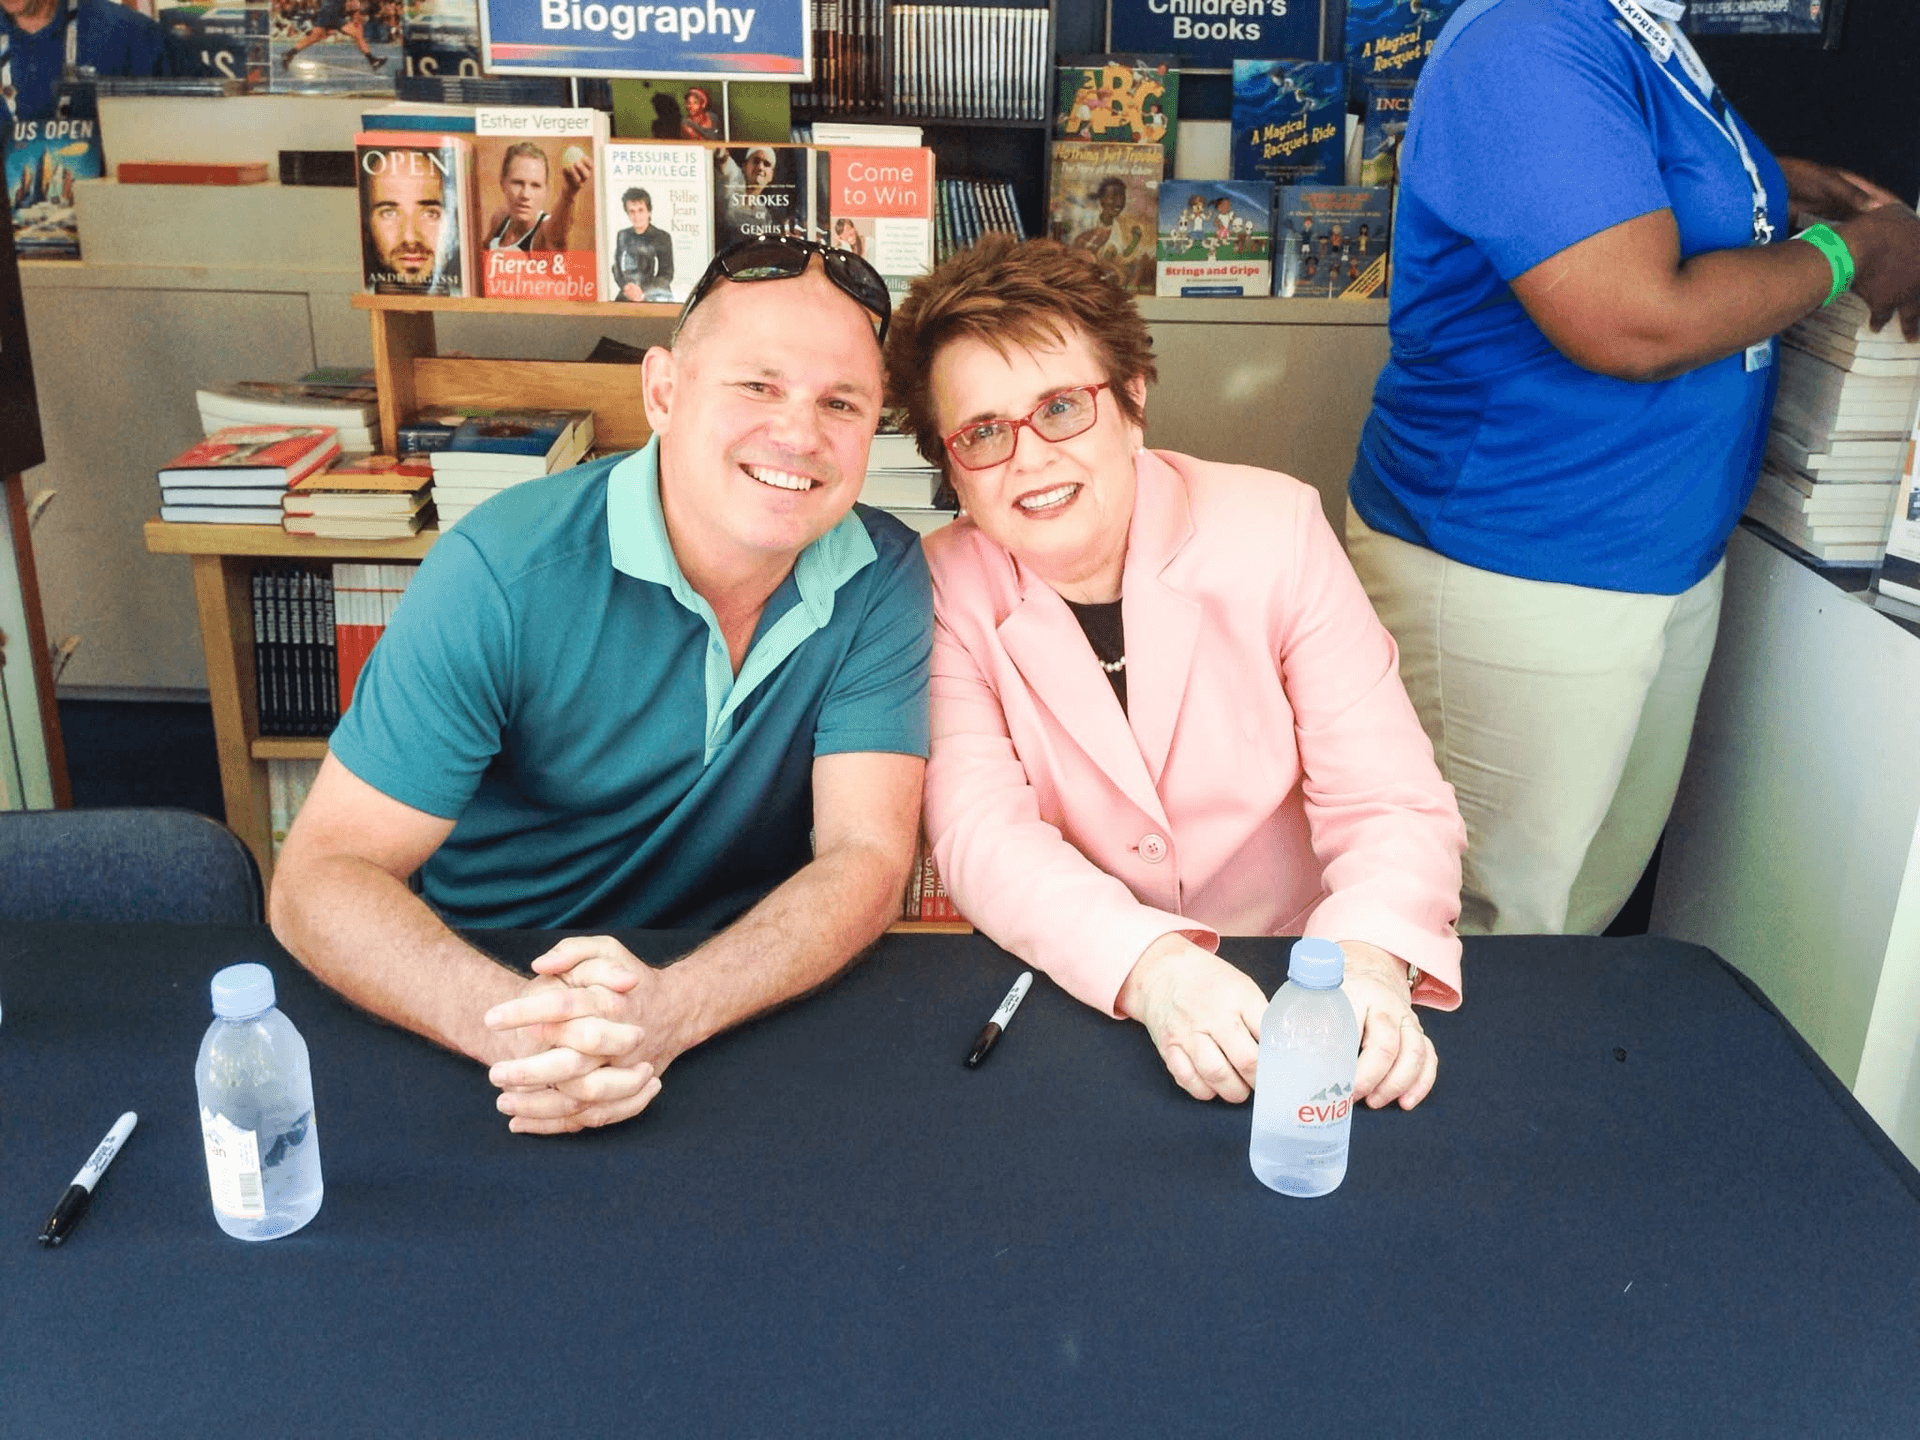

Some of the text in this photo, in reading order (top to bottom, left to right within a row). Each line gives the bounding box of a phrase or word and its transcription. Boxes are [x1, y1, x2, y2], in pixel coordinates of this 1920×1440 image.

[1148, 0, 1287, 16] Children's
[541, 0, 755, 43] Biography
[1173, 16, 1261, 40] Books
[1618, 0, 1668, 47] EXPRESS
[1374, 25, 1421, 54] Magical
[14, 120, 93, 141] US OPEN
[480, 114, 590, 133] Esther Vergeer
[1251, 113, 1307, 145] A Magical
[1263, 123, 1336, 159] Racquet Ride
[362, 150, 451, 177] OPEN
[612, 151, 697, 164] PRESSURE IS
[613, 165, 697, 177] A PRIVILEGE
[847, 162, 914, 183] Come
[669, 189, 699, 204] Billie
[732, 193, 790, 207] STROKES
[843, 186, 917, 206] to Win
[672, 203, 697, 217] Jean
[670, 219, 700, 236] King
[740, 223, 782, 236] GENIUS
[488, 252, 566, 278] fierce &
[1165, 265, 1260, 277] Strings and Grips
[488, 274, 595, 298] vulnerable
